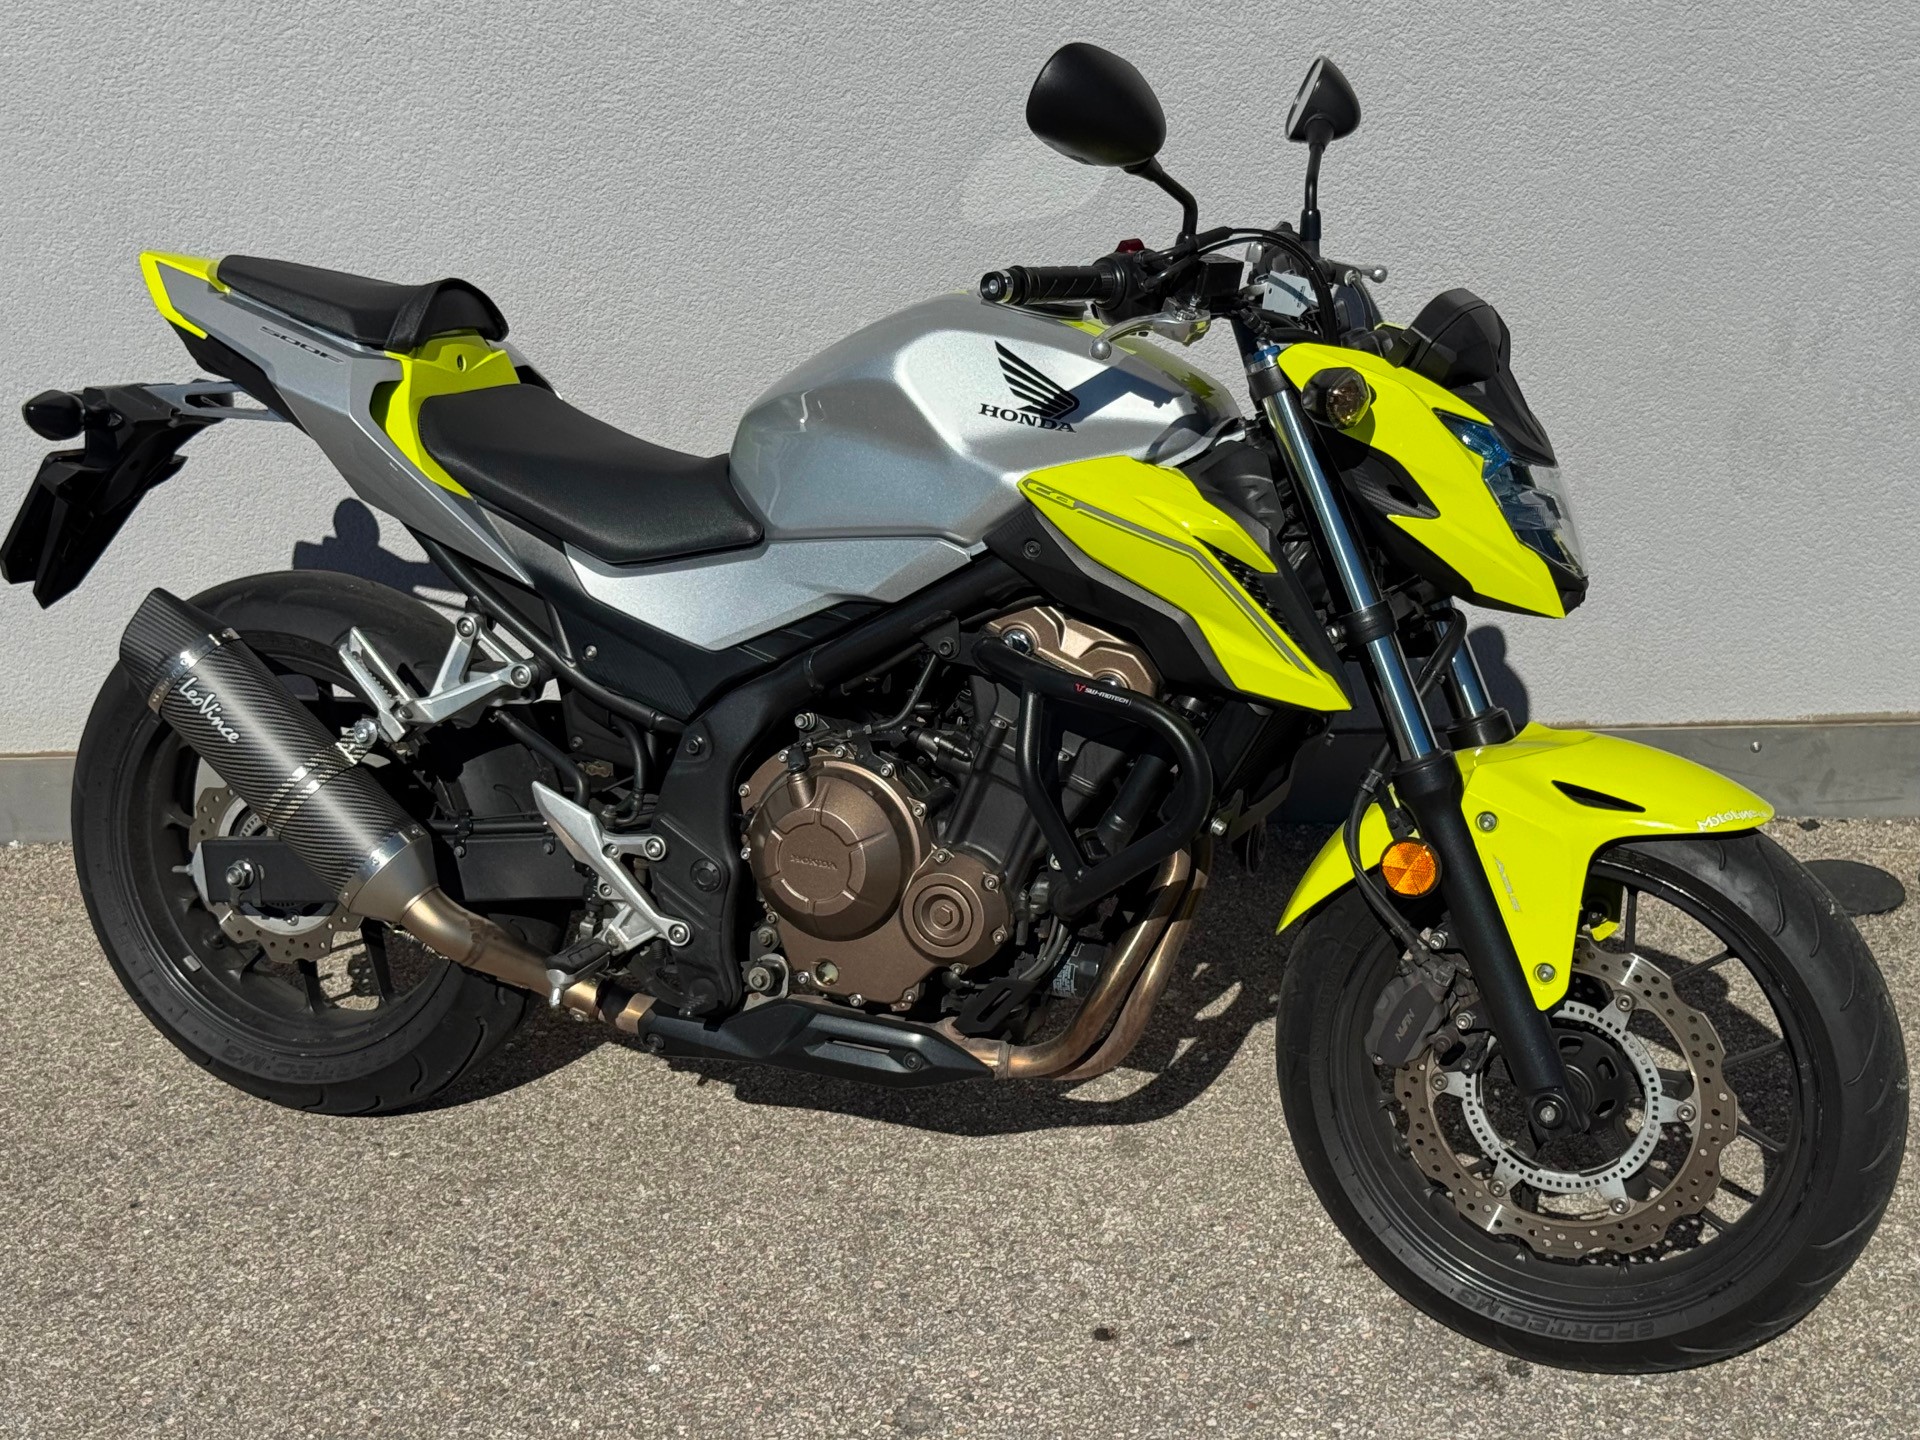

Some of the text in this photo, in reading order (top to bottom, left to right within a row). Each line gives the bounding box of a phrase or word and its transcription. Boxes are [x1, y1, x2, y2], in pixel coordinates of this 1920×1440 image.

[259, 325, 344, 363] 500F
[979, 403, 1077, 433] HONDA
[179, 676, 240, 744] LeoVince
[1085, 687, 1130, 705] SW-MOTECH
[790, 854, 838, 871] HONDA
[1456, 1287, 1656, 1342] SPORTEC M3
